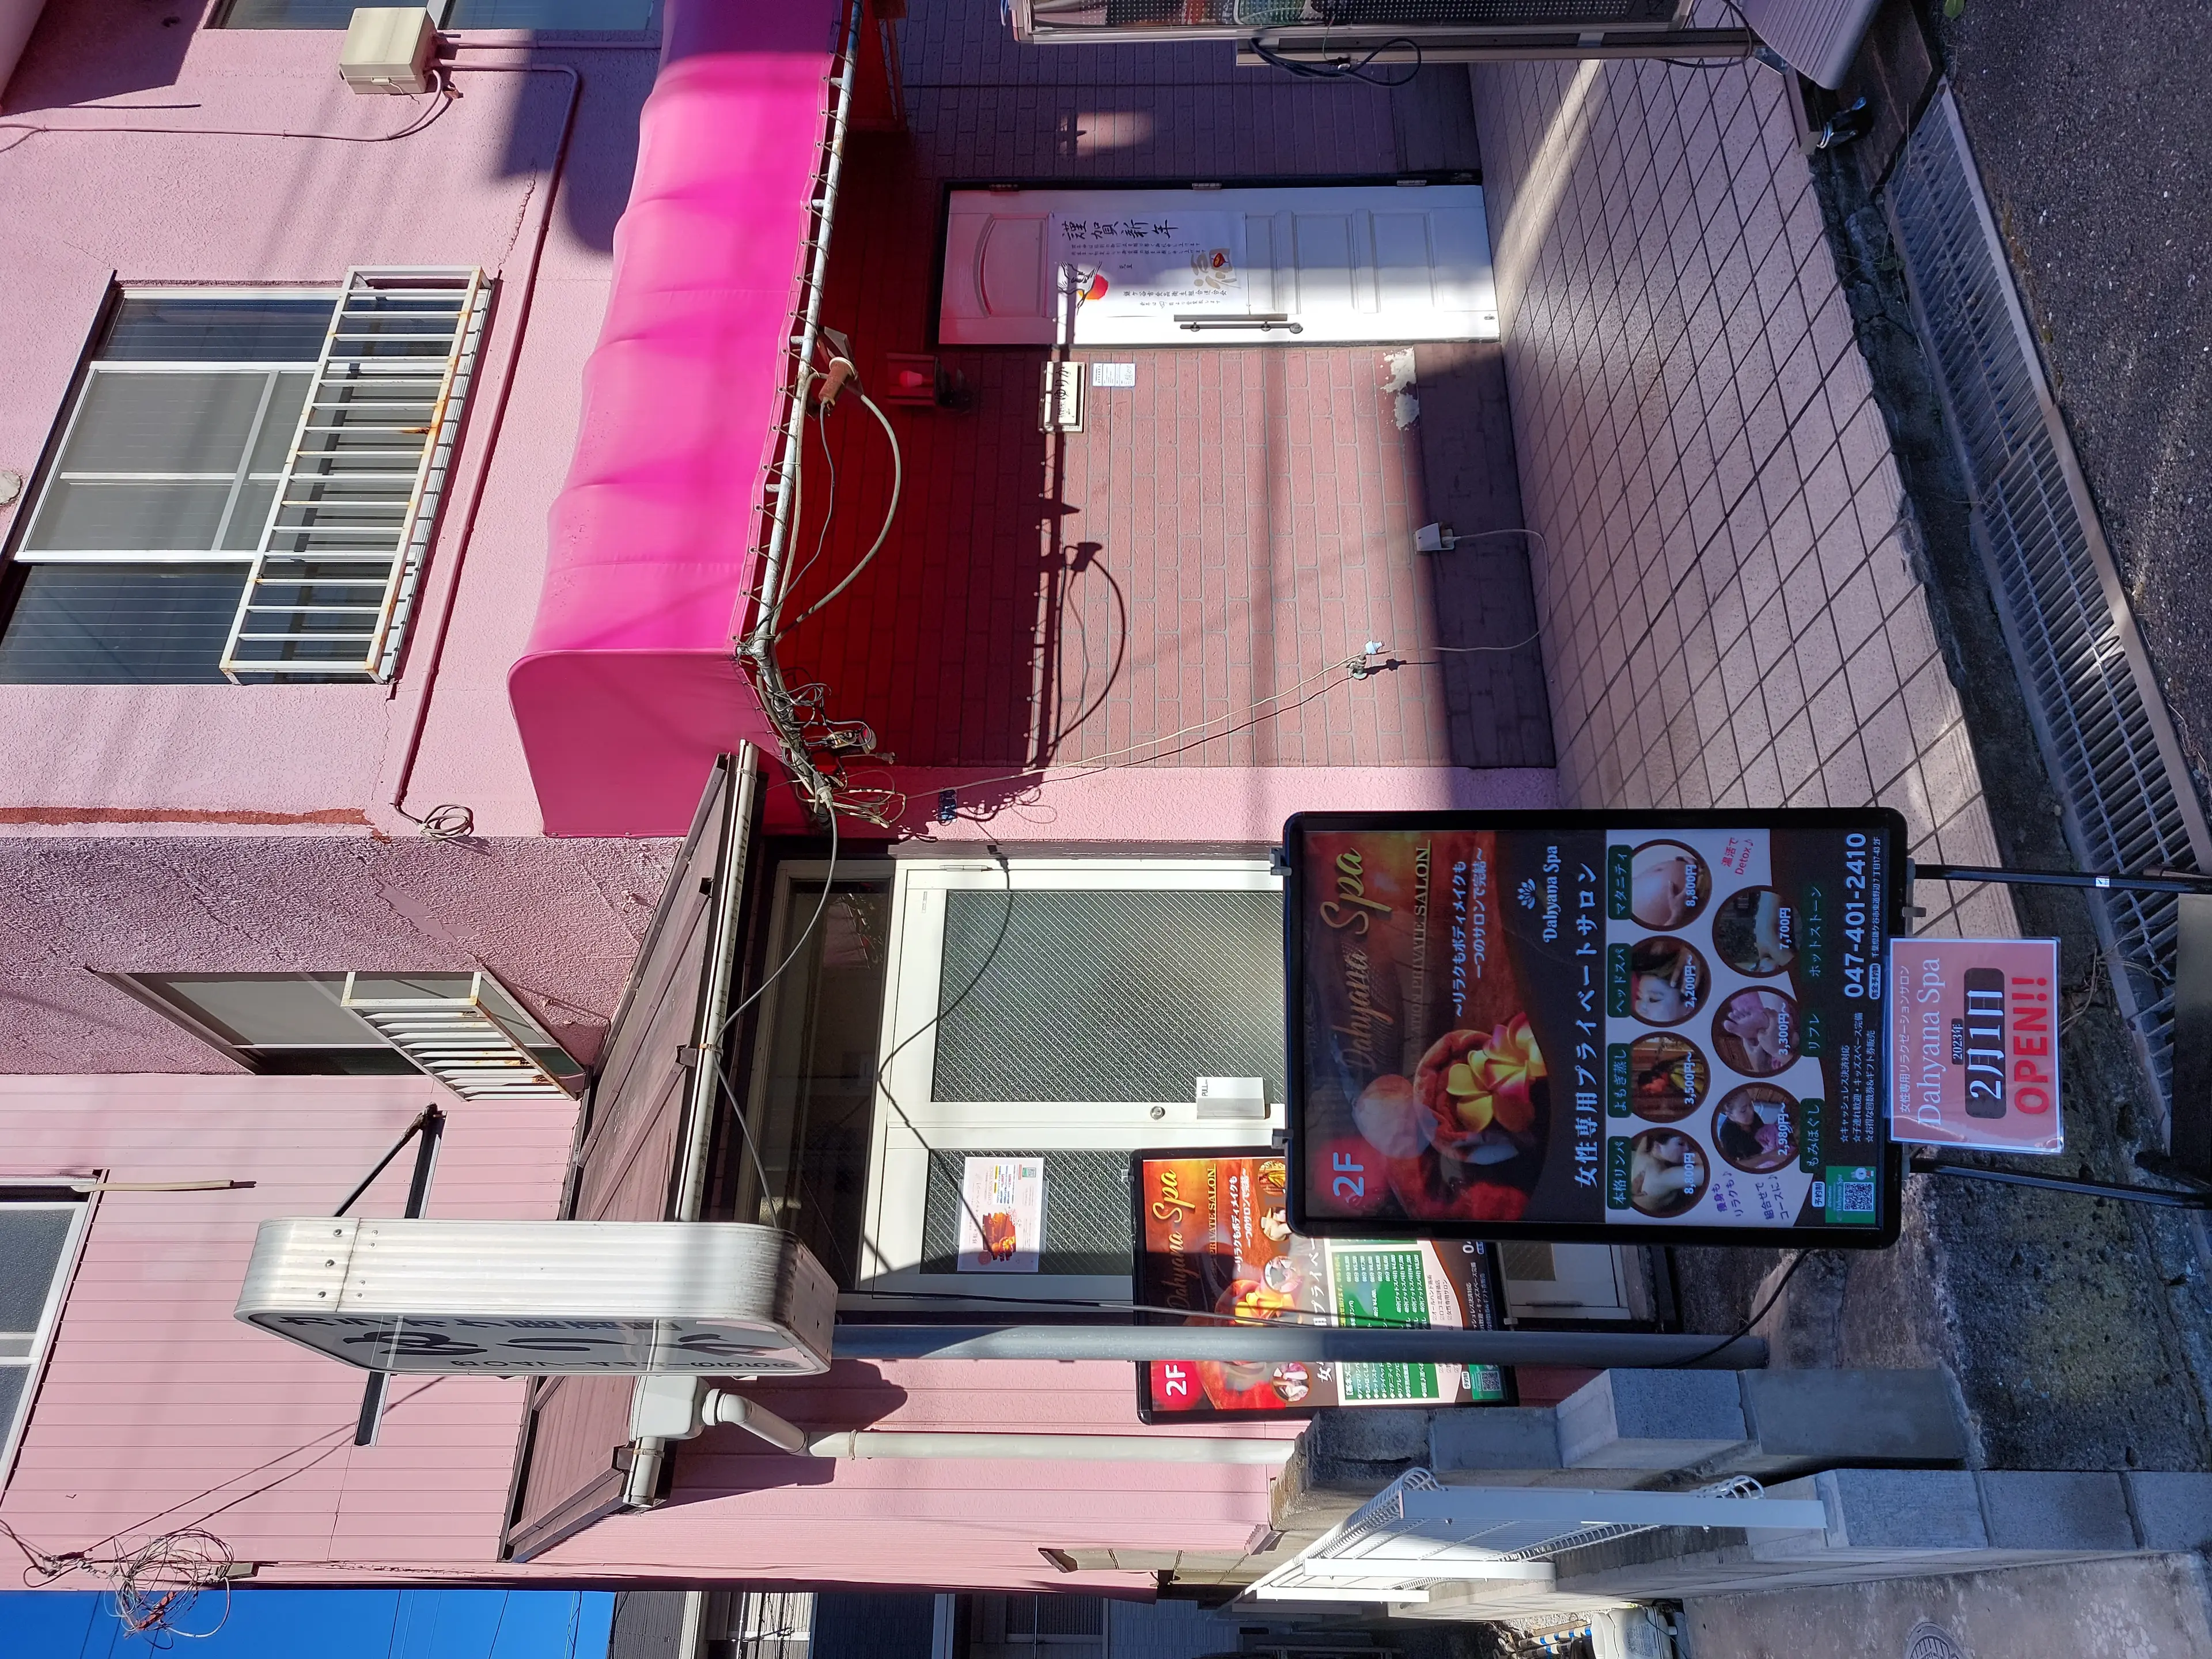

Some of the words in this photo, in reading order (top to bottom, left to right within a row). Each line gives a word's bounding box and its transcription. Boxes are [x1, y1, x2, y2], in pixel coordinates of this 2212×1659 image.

[1062, 219, 1179, 241] 謹賀新年
[1054, 366, 1070, 400] ゆりか
[1414, 846, 1429, 916] SALON
[1543, 845, 1561, 873] Spa
[1721, 837, 1738, 867] 温活で
[1320, 848, 1392, 935] Spa
[1543, 877, 1562, 942] Dahyana
[1615, 852, 1627, 915] マタニティ
[1684, 864, 1697, 907] 8,800円
[1779, 908, 1791, 949] 7,700円
[1809, 887, 1821, 977] ホットストーン
[1844, 833, 1866, 997] 047-401-2410
[1411, 921, 1425, 990] PRIVATE
[1615, 948, 1626, 1013] ヘッドスパ
[1916, 958, 1946, 1003] Spa
[1331, 950, 1393, 1069] Dahyana
[1574, 862, 1598, 1188] 女性専用プライベートサロン
[1808, 1014, 1820, 1050] リフレ
[1899, 965, 1911, 1112] 女性専用リラクゼーションサロン
[1916, 1011, 1947, 1125] Dahyana
[1951, 1024, 1964, 1060] 2023年
[1966, 990, 2004, 1099] 2月1日
[2012, 977, 2049, 1114] OPEN!!
[1613, 1049, 1626, 1112] よもぎ蒸し
[1807, 1105, 1820, 1166] もみほぐし
[1152, 1169, 1195, 1223] Spa
[1207, 1168, 1216, 1211] SALON
[1332, 1152, 1365, 1197] 2F
[1613, 1141, 1626, 1205] 本格リンパ
[1684, 1152, 1695, 1195] 8,800円
[1755, 1182, 1775, 1219] 組合せで
[1208, 1214, 1217, 1254] PRIVATE
[1161, 1231, 1200, 1309] Dahyana
[343, 1331, 781, 1357] ゆりか
[1165, 1364, 1187, 1396] 2F
